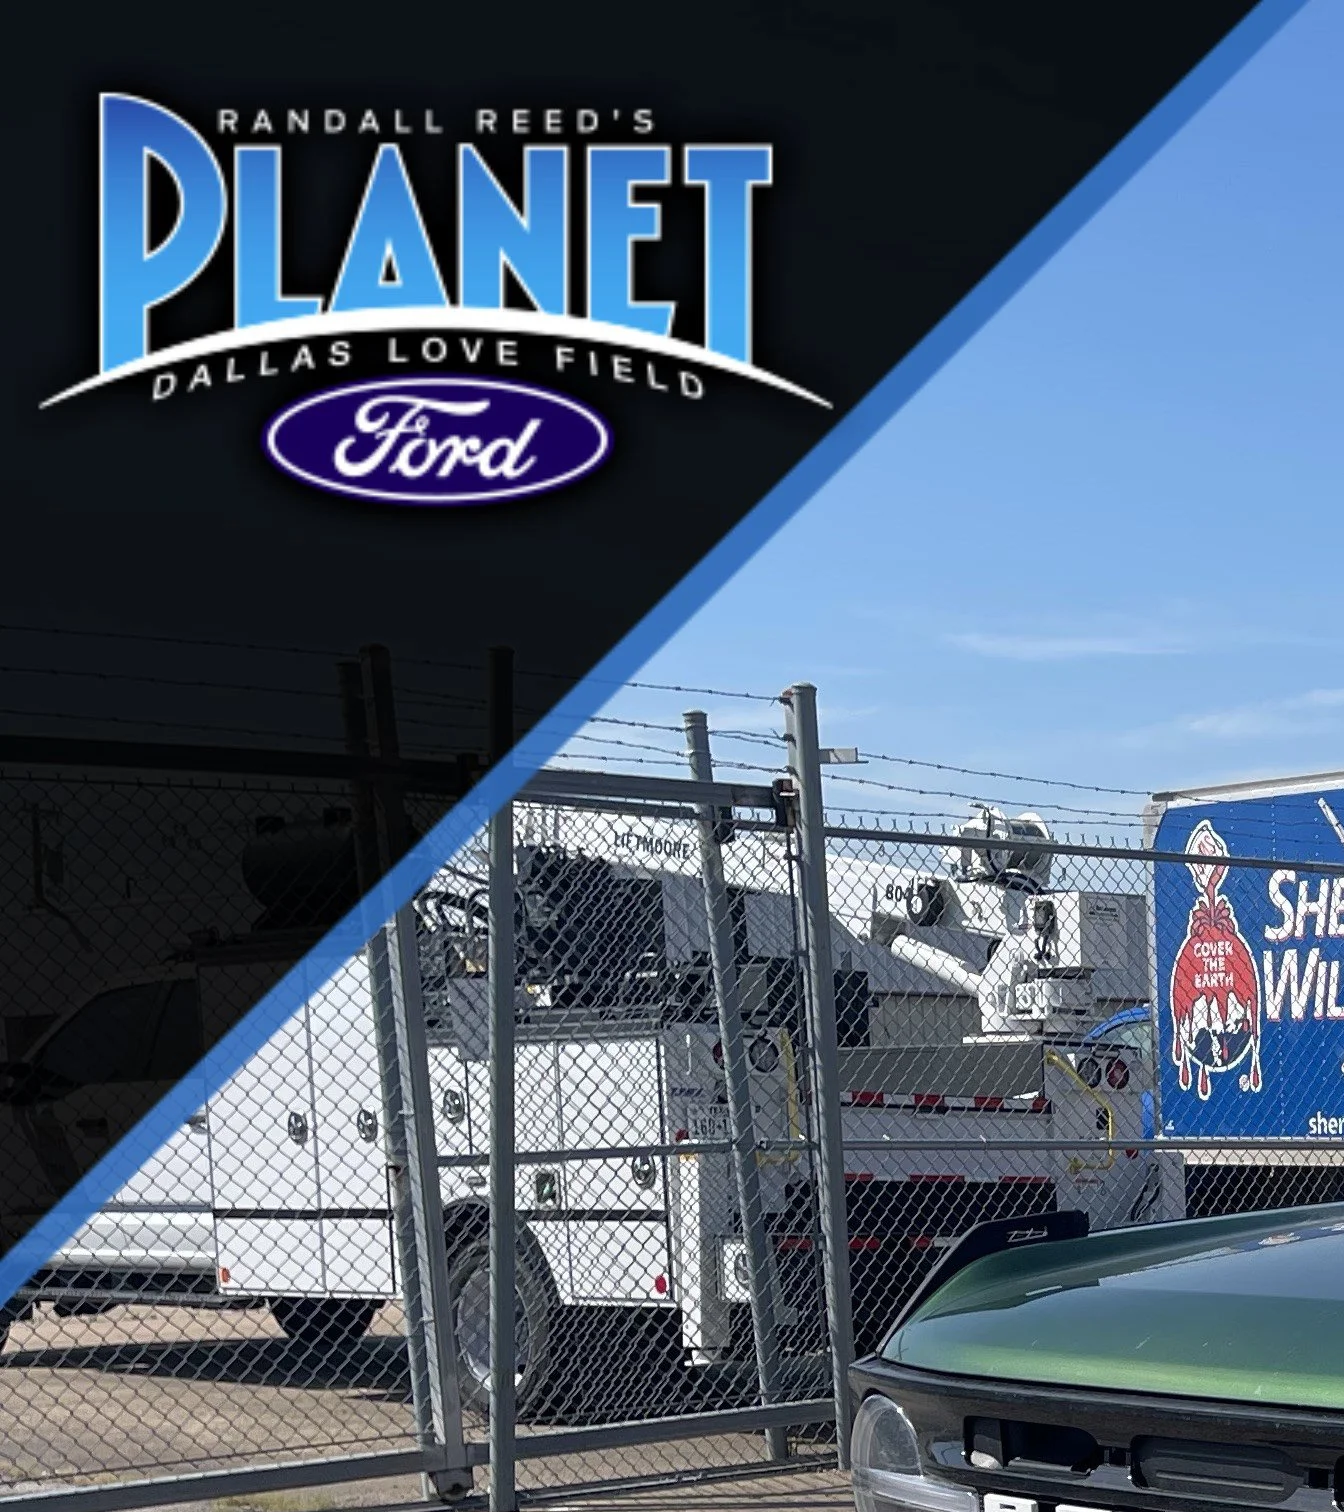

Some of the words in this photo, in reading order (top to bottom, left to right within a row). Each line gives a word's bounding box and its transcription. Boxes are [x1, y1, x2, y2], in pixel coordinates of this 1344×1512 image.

[1194, 941, 1234, 957] COVER
[1202, 956, 1226, 972] THE
[1194, 972, 1234, 988] EARTH
